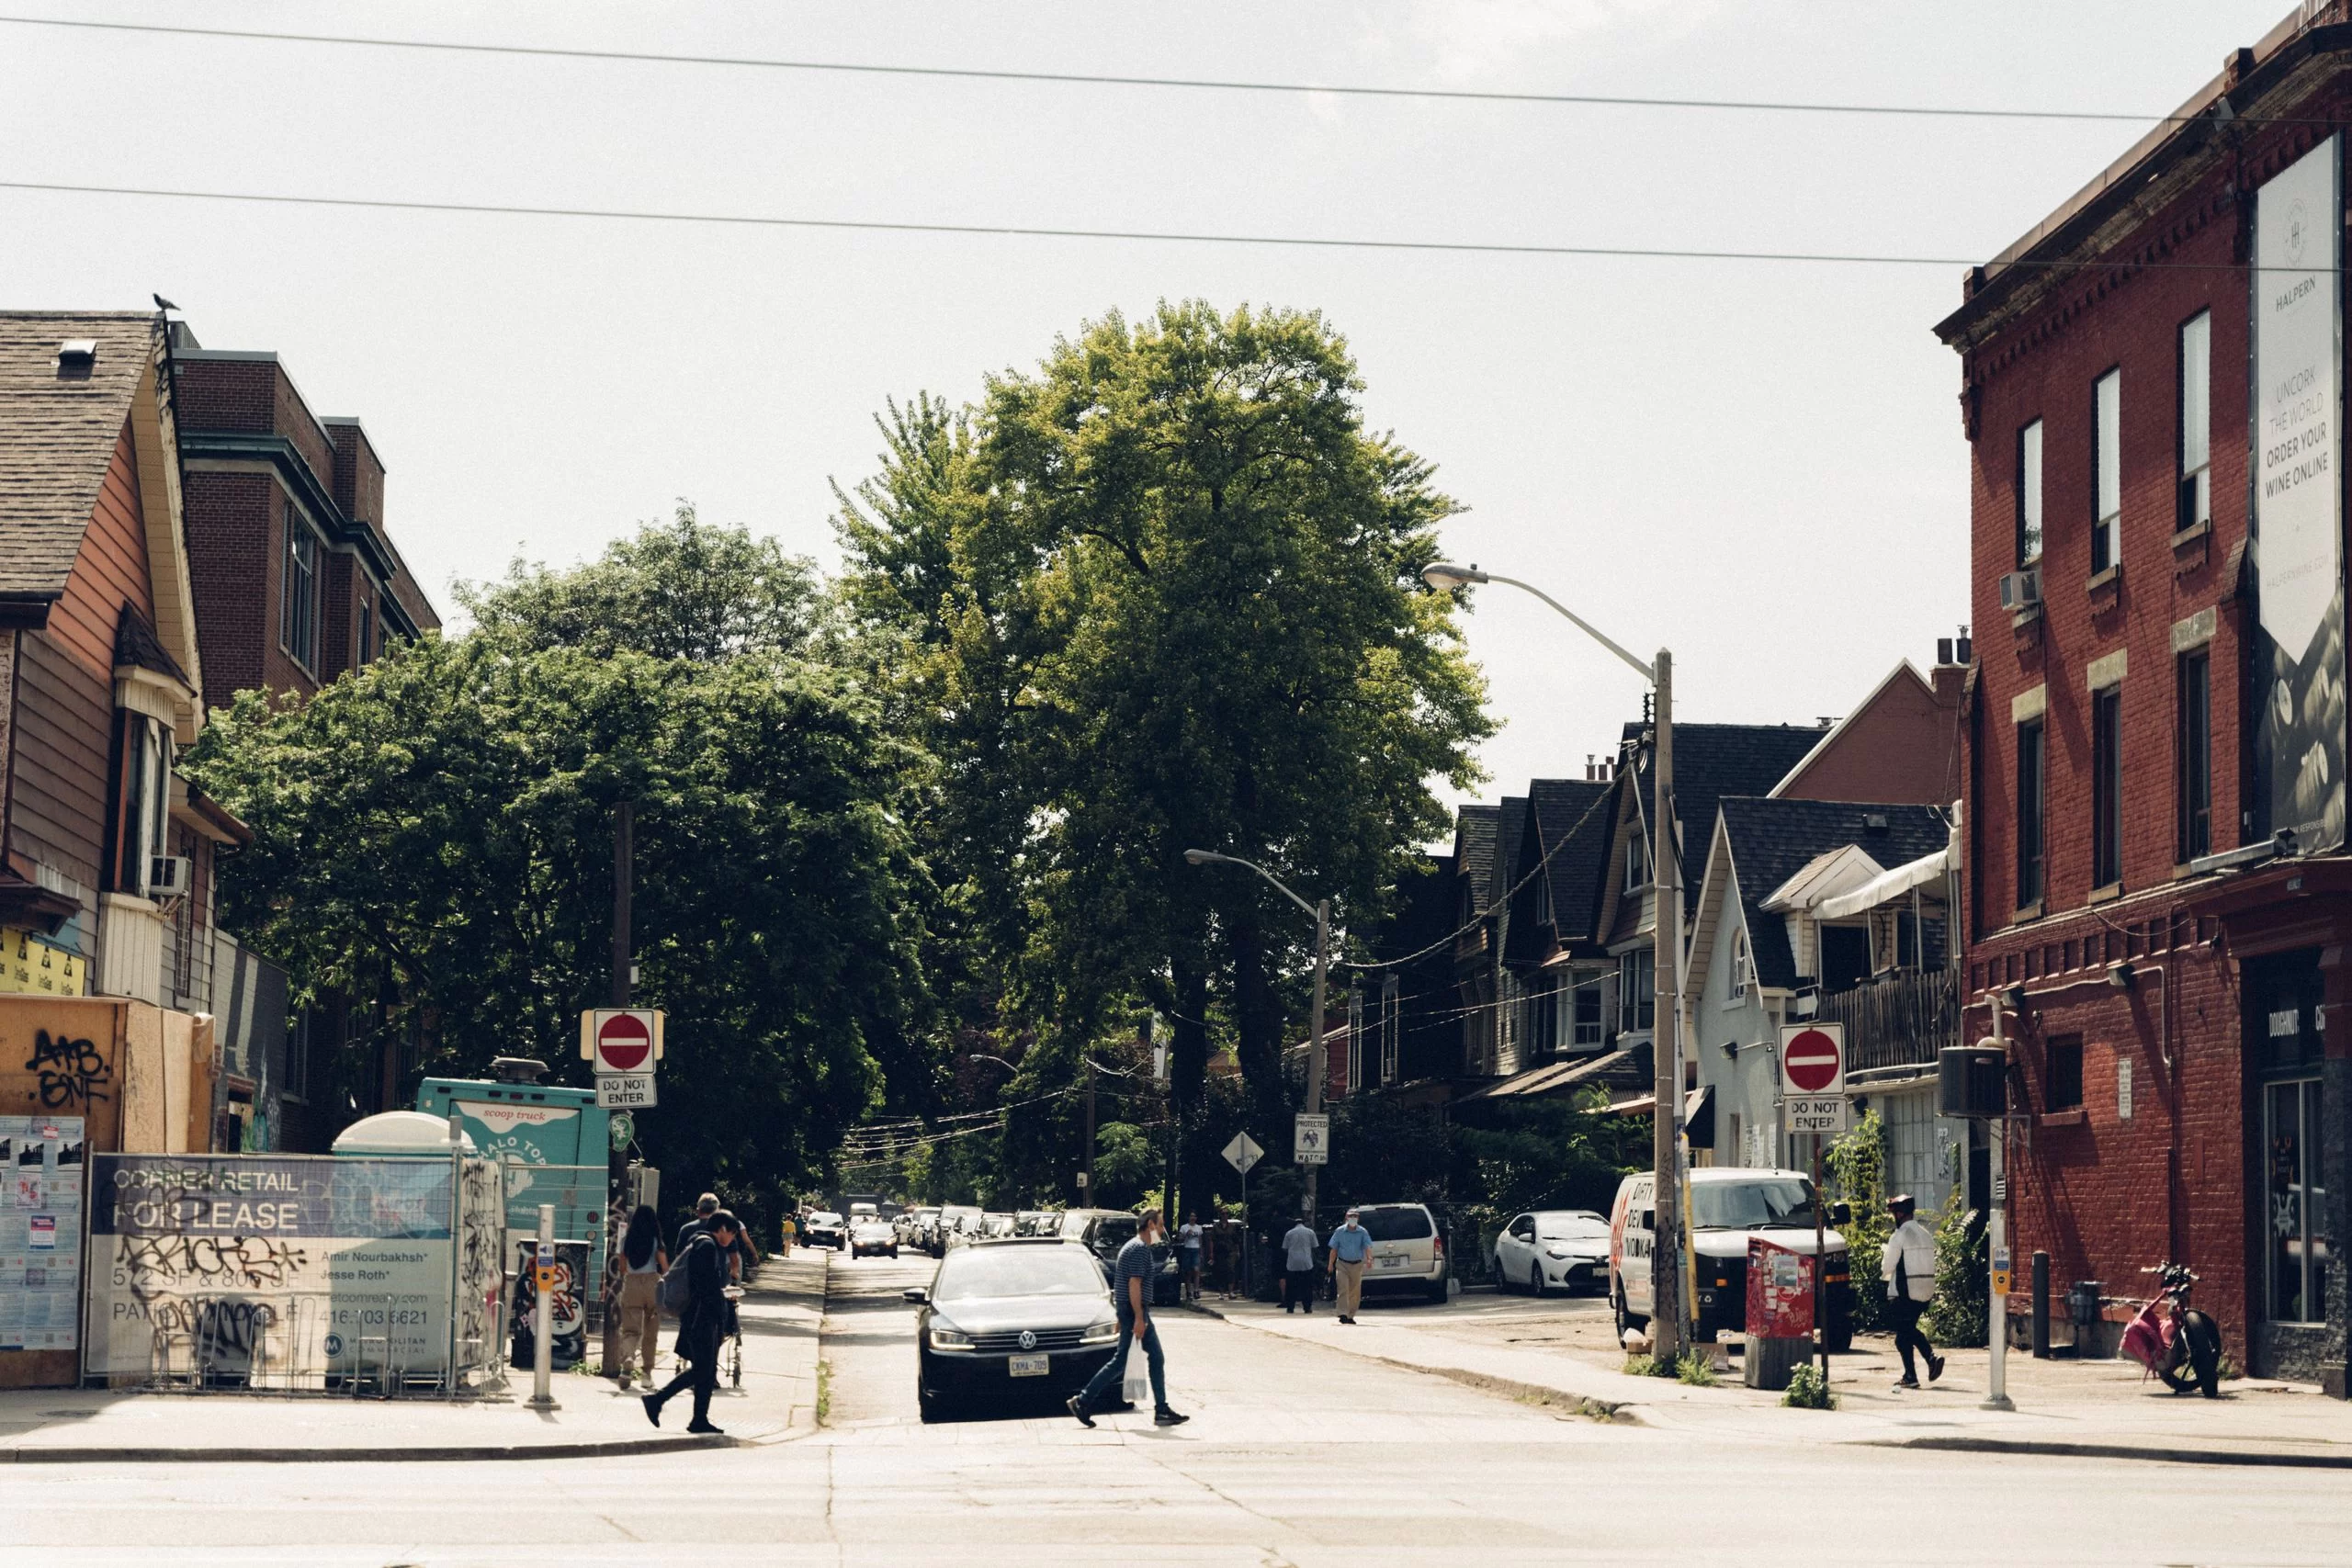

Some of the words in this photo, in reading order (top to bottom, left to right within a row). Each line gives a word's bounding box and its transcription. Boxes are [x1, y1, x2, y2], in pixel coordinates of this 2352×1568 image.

[2276, 276, 2316, 312] HALPERN
[2277, 367, 2315, 403] UNCORK
[2269, 412, 2288, 438] THE
[2290, 392, 2324, 426] WORLD
[2267, 436, 2299, 468] ORDER
[2301, 422, 2326, 450] YOUR
[2266, 471, 2290, 499] WINE
[2293, 451, 2328, 486] ONLINE
[603, 1080, 619, 1091] DO
[625, 1079, 647, 1089] NOT
[608, 1093, 644, 1103] ENTER
[1792, 1102, 1808, 1113] DO
[1815, 1102, 1839, 1113] NOT
[483, 1109, 514, 1121] scoop
[516, 1111, 547, 1121] truck
[1296, 1120, 1328, 1128] PROTECTED
[478, 1137, 517, 1161] HALO
[525, 1141, 547, 1165] TOP
[114, 1169, 213, 1190] CORNER
[221, 1171, 299, 1191] RETAIL
[1633, 1182, 1655, 1201] DIRTY
[113, 1201, 182, 1228] FOR
[193, 1202, 299, 1229] LEASE
[1627, 1209, 1645, 1228] DEVI
[322, 1252, 349, 1262] Amir
[1625, 1237, 1651, 1258] VODKA
[162, 1268, 189, 1286] SF
[199, 1269, 213, 1287] &
[321, 1270, 355, 1280] Jesse
